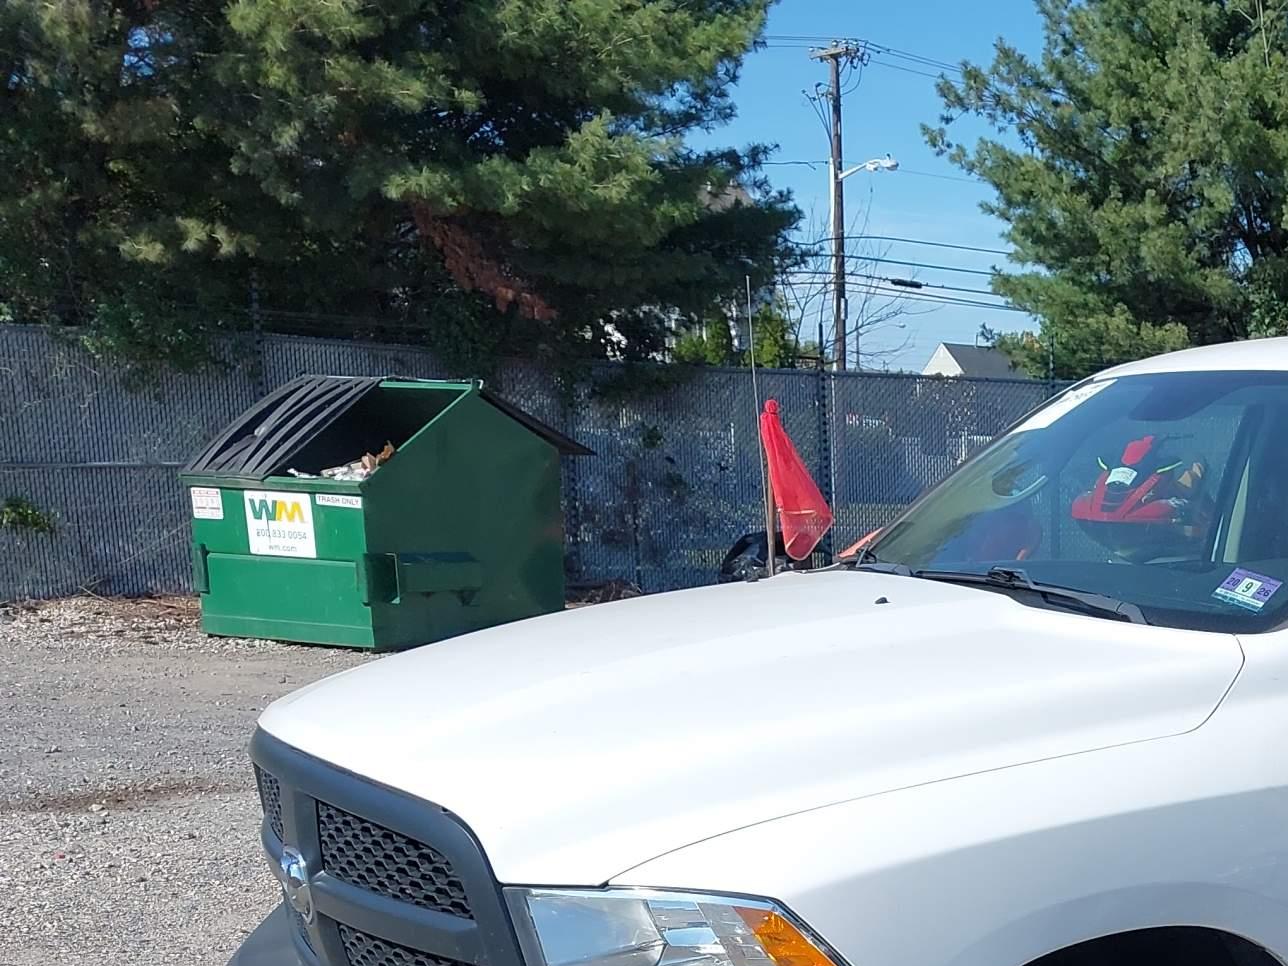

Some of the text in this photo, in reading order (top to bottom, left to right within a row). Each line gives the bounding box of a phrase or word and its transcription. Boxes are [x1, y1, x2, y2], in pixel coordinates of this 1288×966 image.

[317, 495, 359, 506] TRASH ONLY
[248, 498, 304, 523] WM
[268, 545, 297, 553] wm.com
[1226, 577, 1241, 587] 20
[1242, 581, 1254, 593] 9
[1257, 587, 1272, 597] 26
